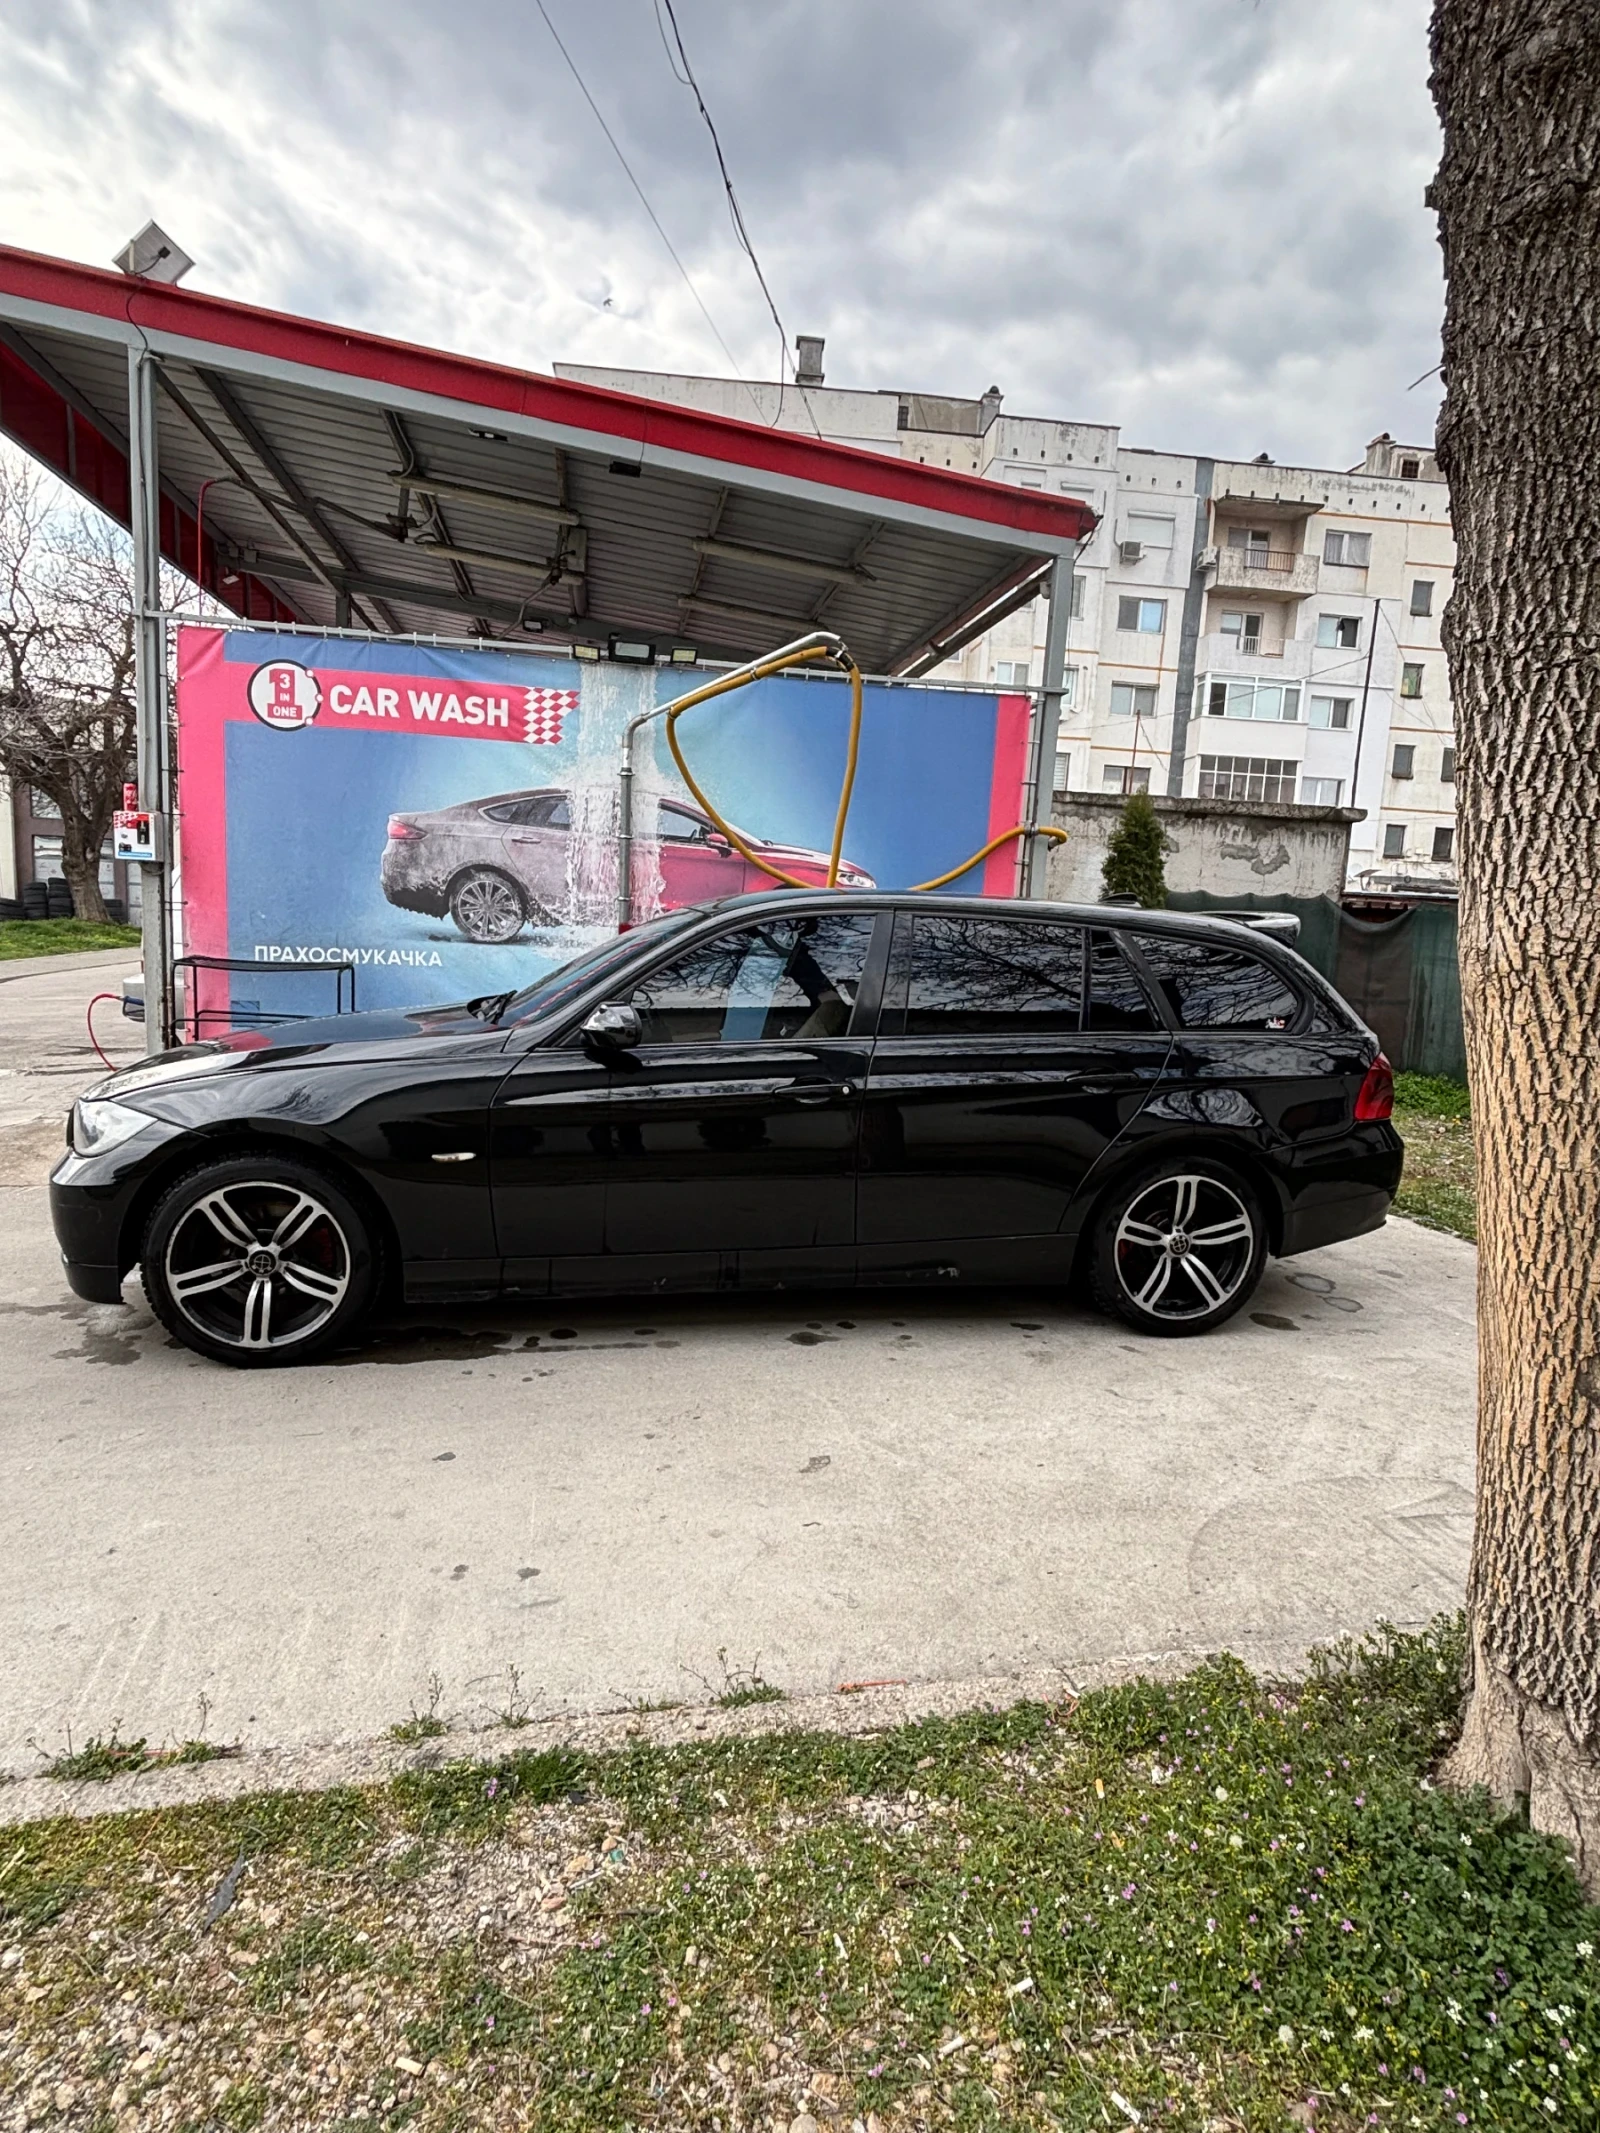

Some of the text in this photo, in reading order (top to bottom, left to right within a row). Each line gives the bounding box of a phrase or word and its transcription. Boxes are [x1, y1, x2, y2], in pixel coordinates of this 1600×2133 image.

[279, 673, 291, 689] 3
[279, 693, 290, 702] IN
[272, 705, 297, 718] ONE
[330, 684, 509, 728] CAR WASH
[254, 945, 443, 967] ПРАХОСМУКАЧКА
